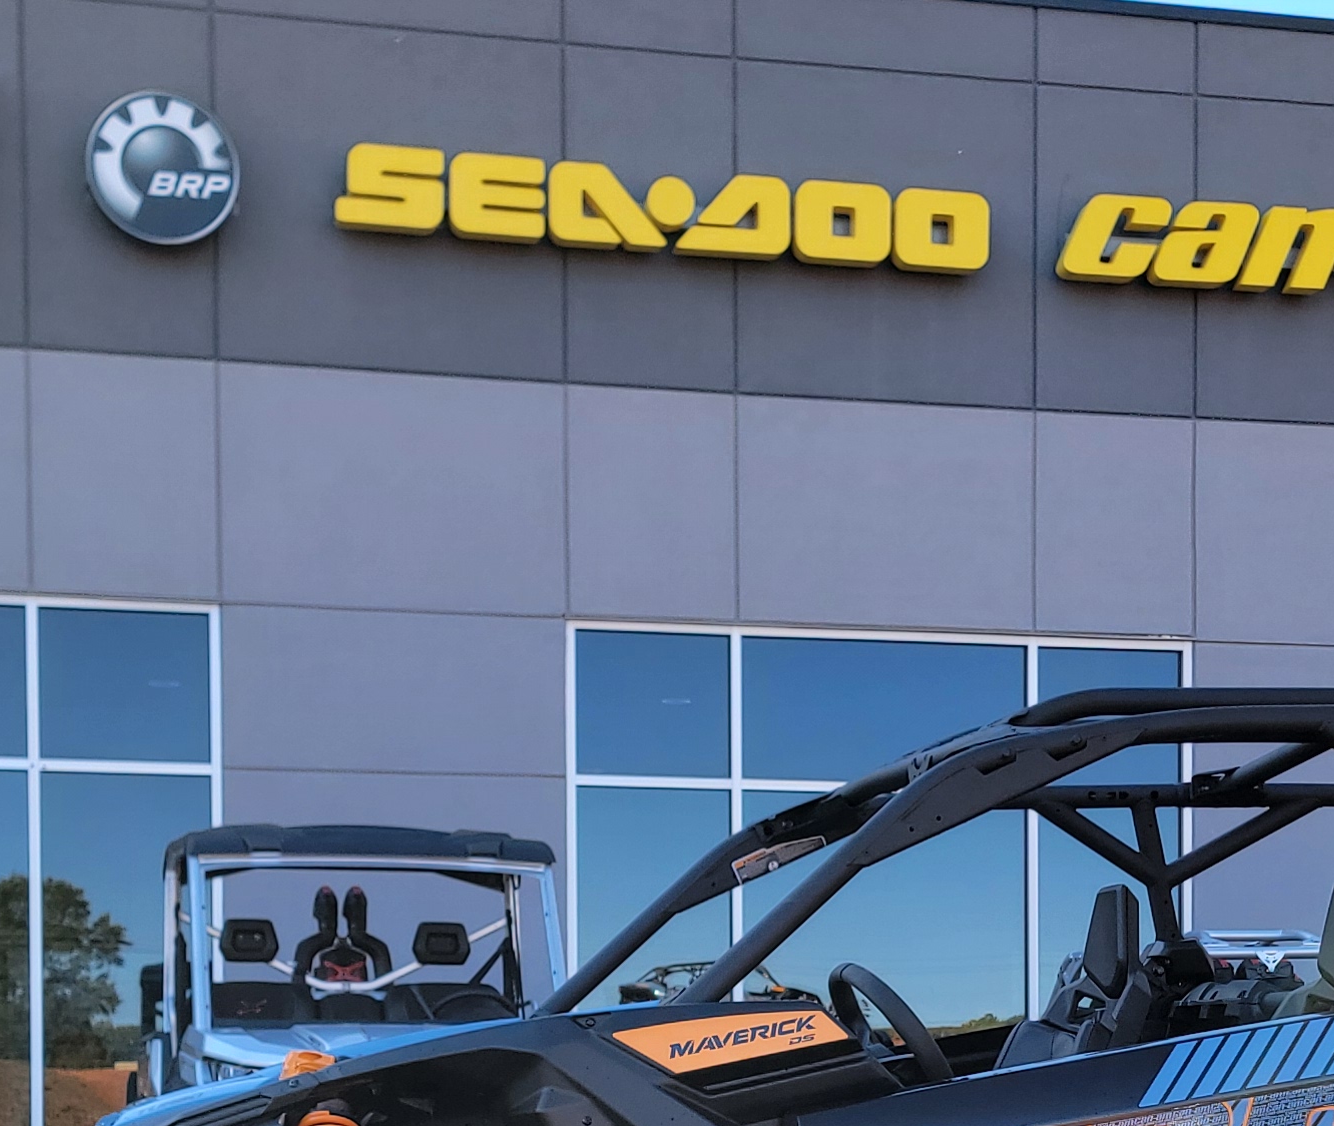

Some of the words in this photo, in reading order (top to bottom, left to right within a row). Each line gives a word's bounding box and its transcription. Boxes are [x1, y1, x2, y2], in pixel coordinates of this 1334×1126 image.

[147, 169, 232, 200] BRP
[668, 1014, 817, 1059] MAVERICK
[788, 1033, 817, 1046] DS
